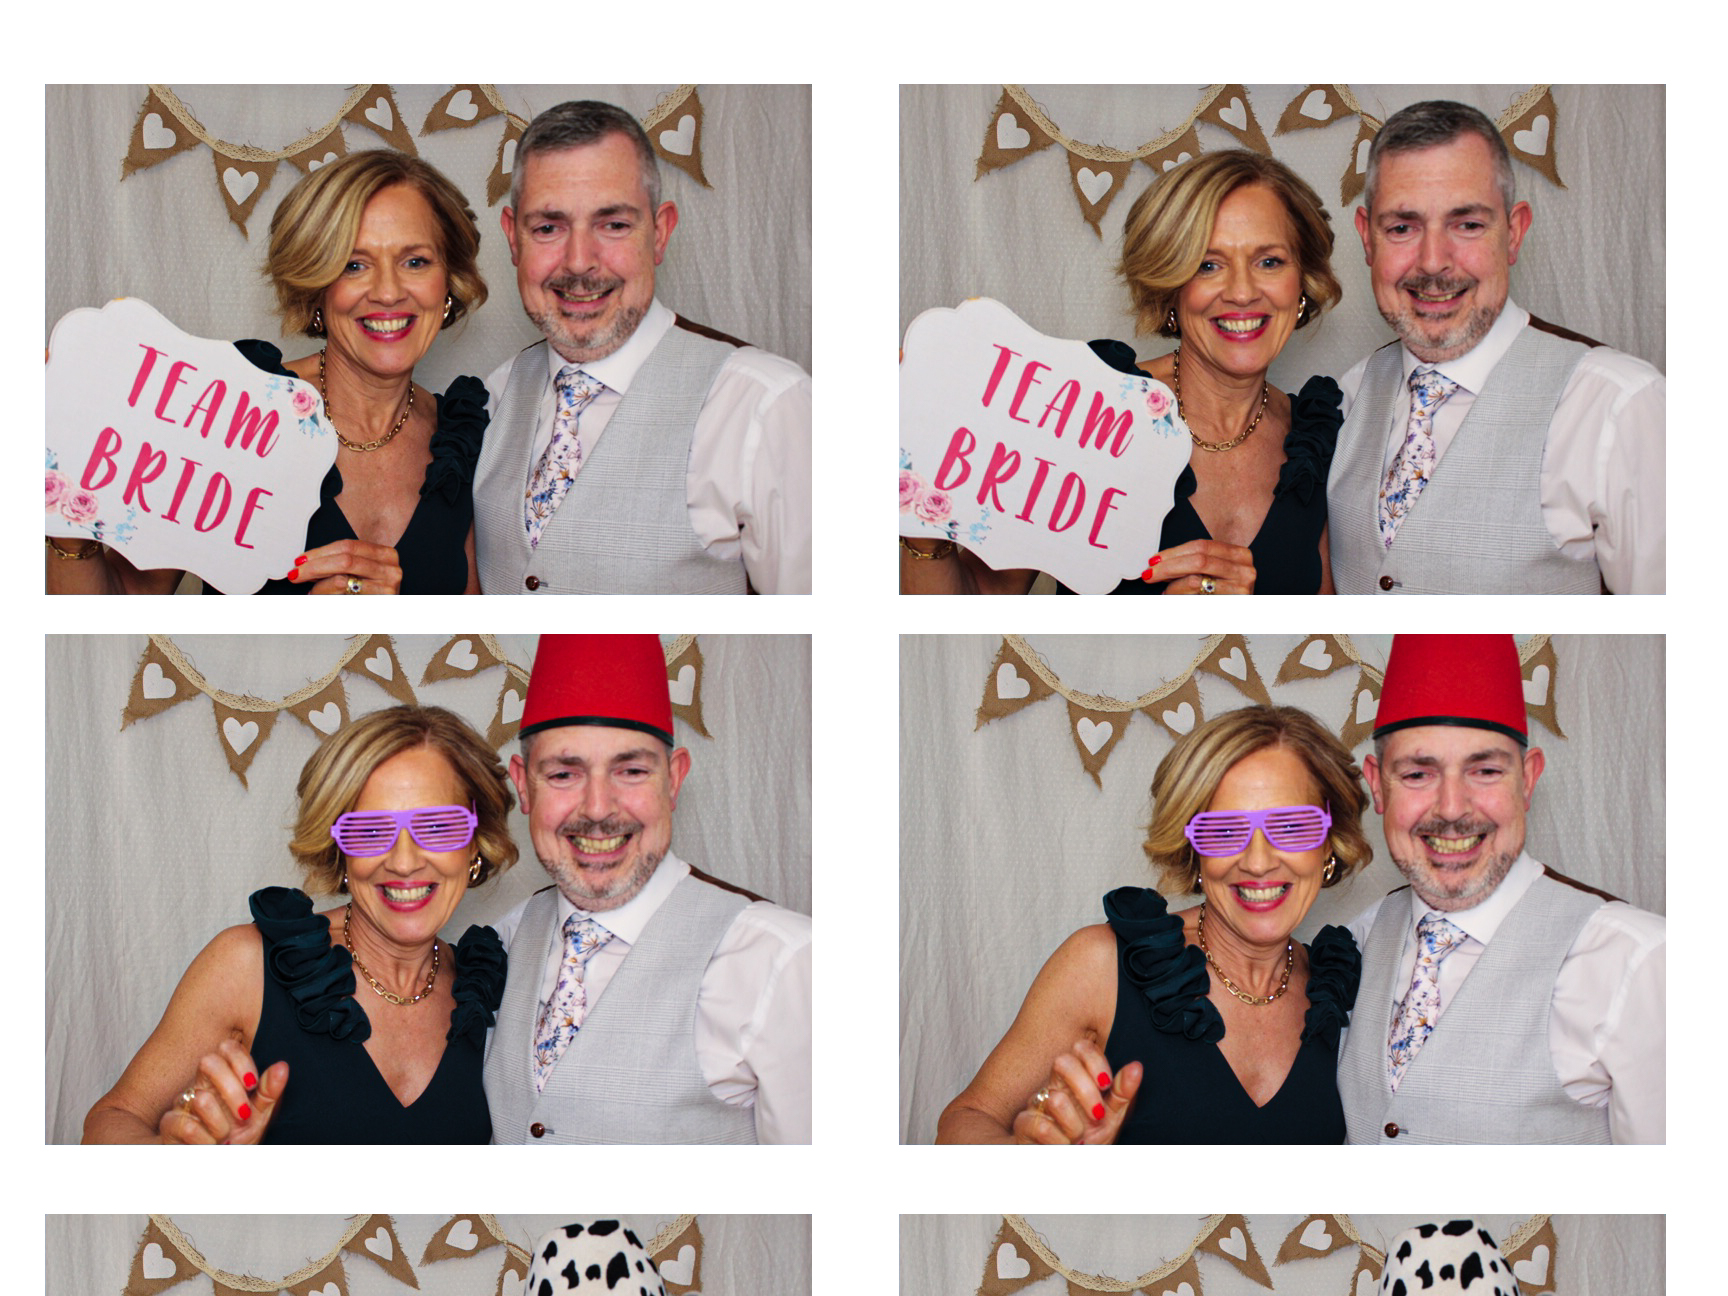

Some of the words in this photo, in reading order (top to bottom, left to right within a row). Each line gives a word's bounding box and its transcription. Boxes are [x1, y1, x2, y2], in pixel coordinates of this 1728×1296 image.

[127, 343, 280, 458] TEAM
[981, 343, 1134, 458] TEAM
[80, 427, 273, 549] BRIDE
[934, 427, 1127, 549] BRIDE
